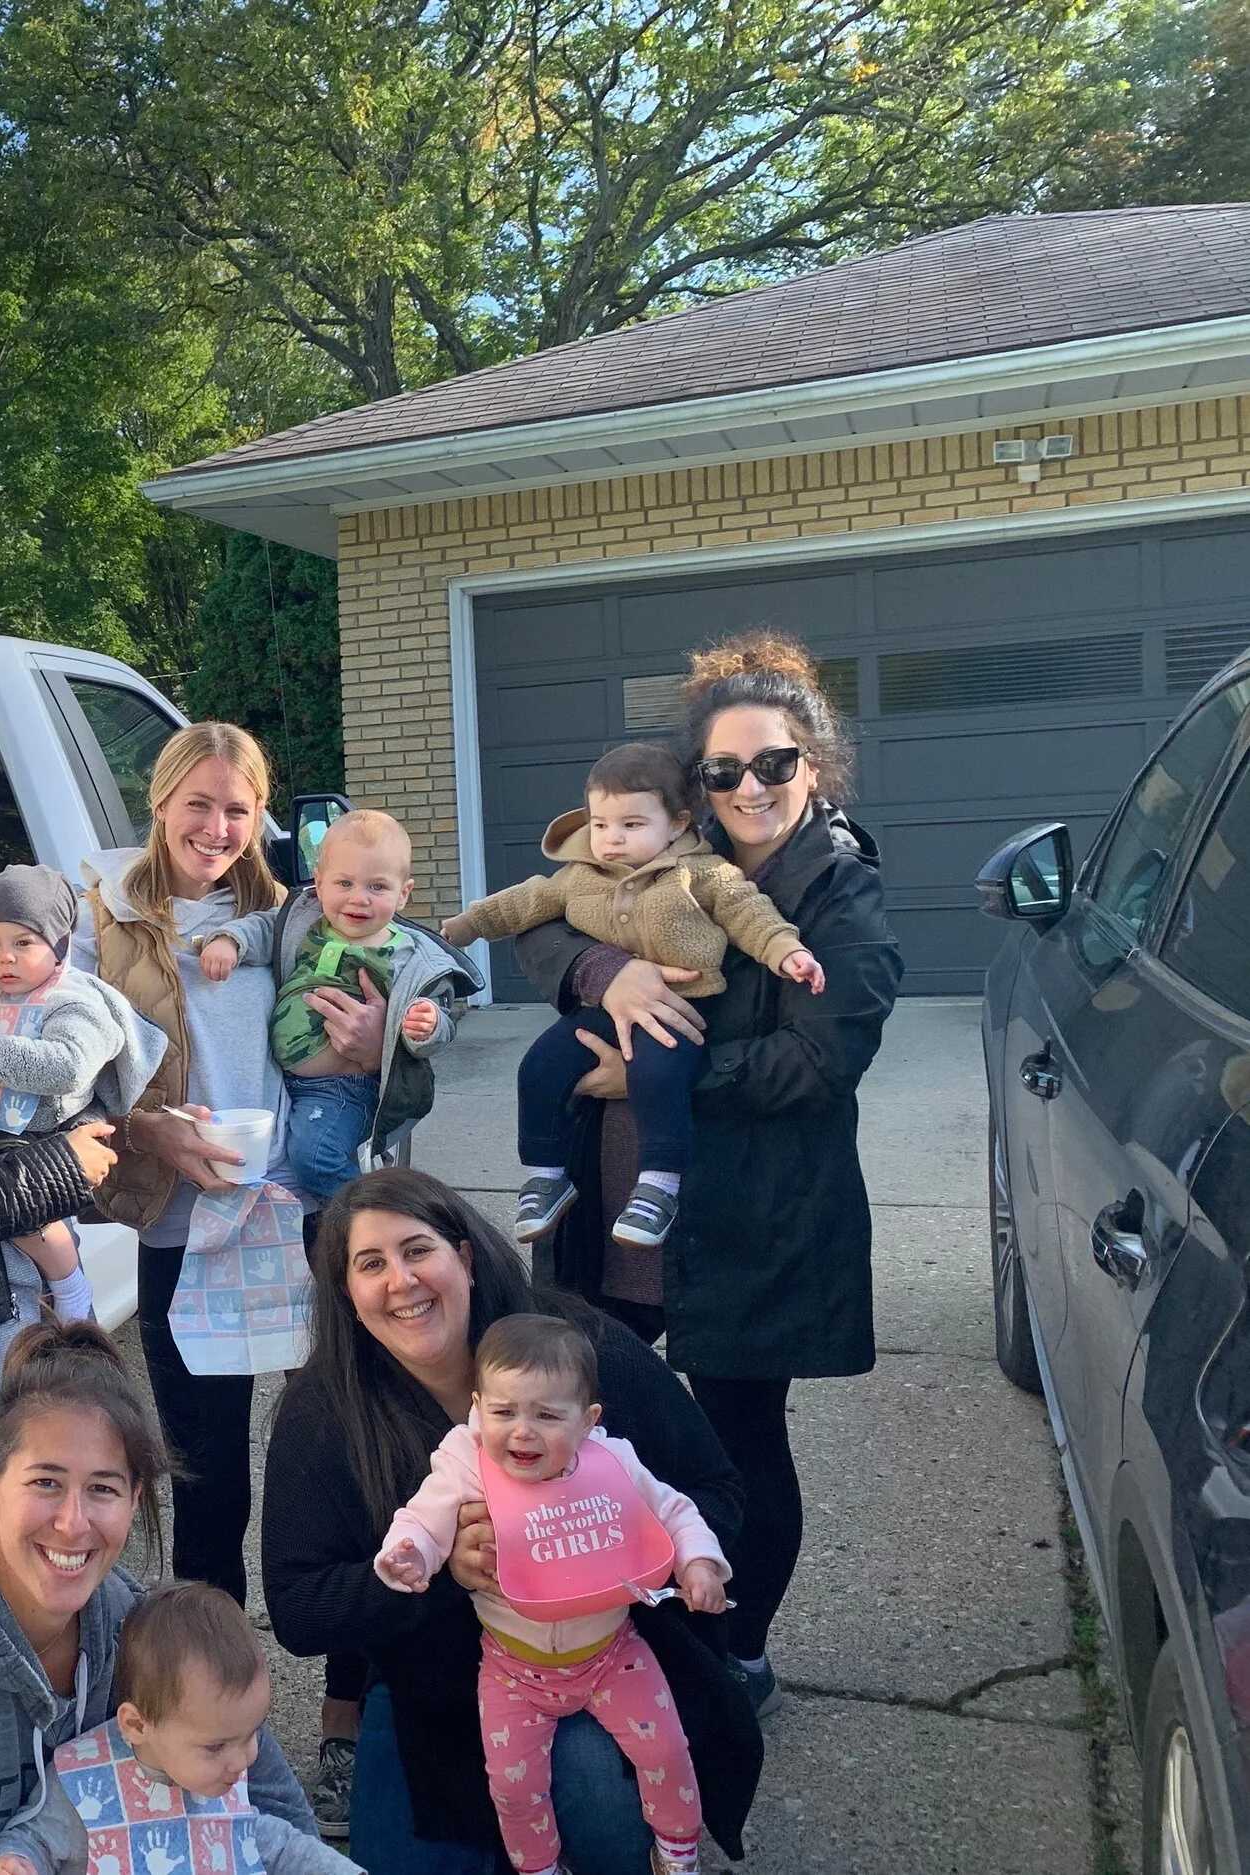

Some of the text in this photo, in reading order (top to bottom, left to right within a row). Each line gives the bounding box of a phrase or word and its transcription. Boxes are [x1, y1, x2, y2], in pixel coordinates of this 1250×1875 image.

[524, 1493, 611, 1524] who runs
[524, 1502, 622, 1541] the world?
[531, 1523, 625, 1563] GIRLS
